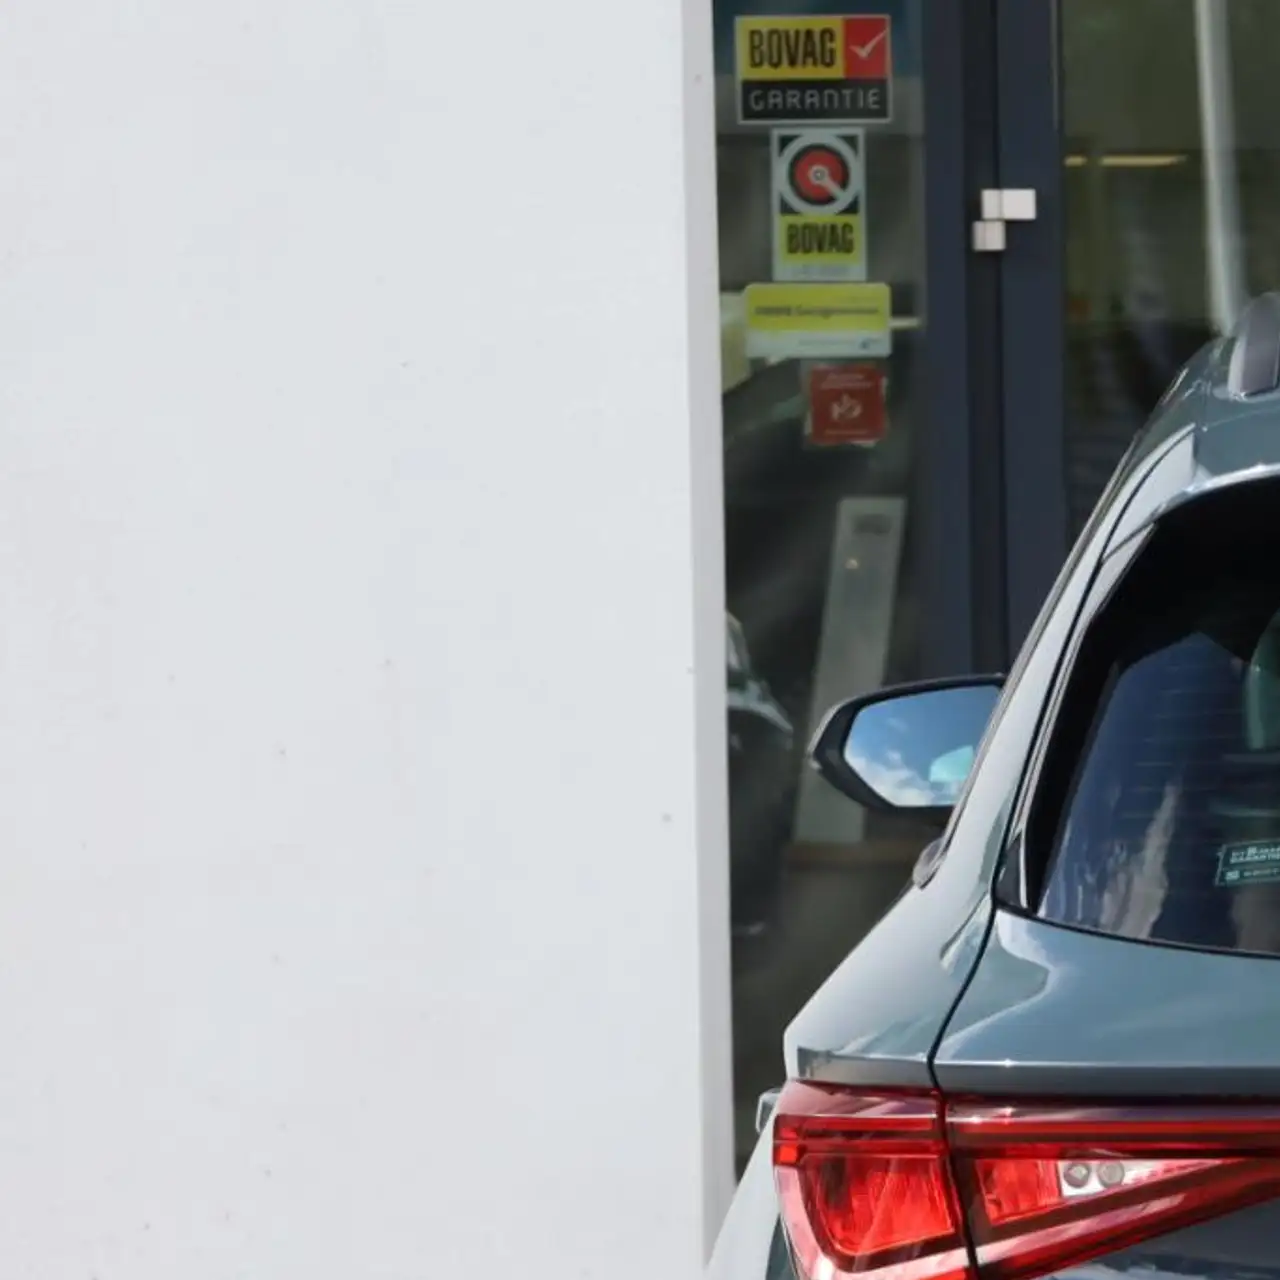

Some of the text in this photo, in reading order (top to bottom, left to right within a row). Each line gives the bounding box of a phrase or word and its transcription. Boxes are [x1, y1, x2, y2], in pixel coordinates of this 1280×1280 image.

[749, 27, 836, 69] BOVAG
[750, 88, 881, 111] GARANTIE
[787, 222, 854, 254] BOVAG
